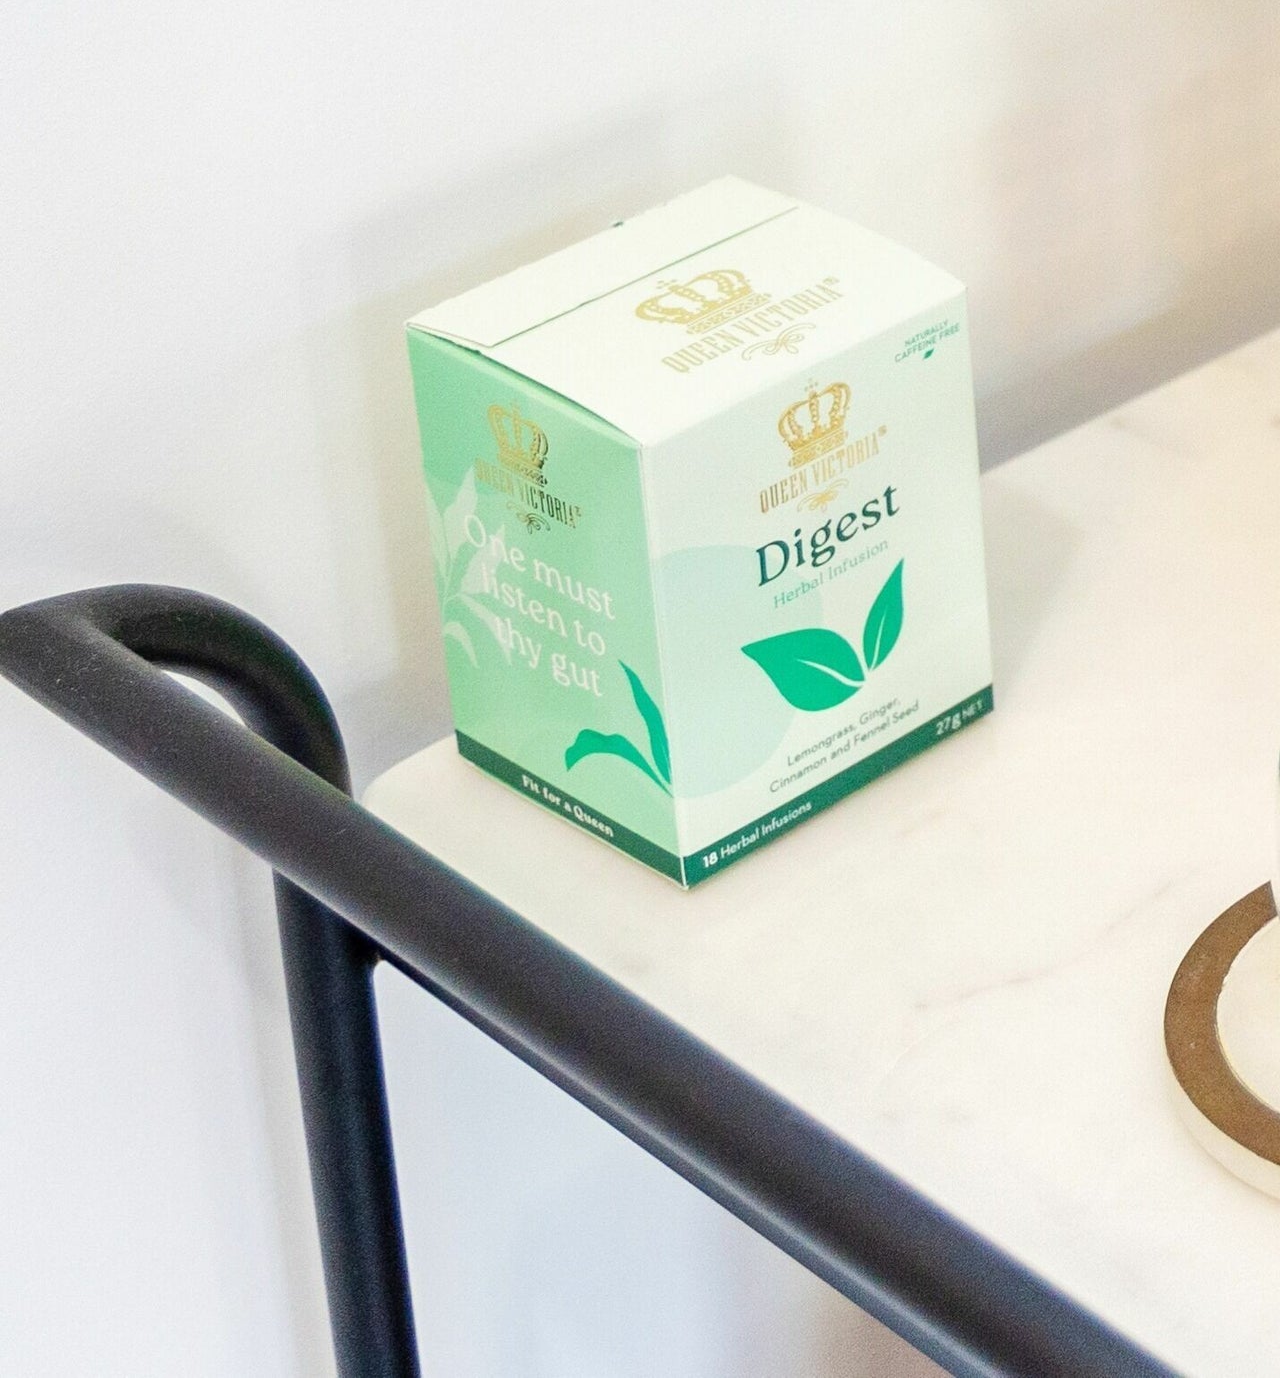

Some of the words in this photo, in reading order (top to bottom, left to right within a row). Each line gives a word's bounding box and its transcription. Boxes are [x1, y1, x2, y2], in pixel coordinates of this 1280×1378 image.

[661, 329, 745, 373] QUEEN
[894, 334, 936, 363] CAFFEINE
[939, 322, 960, 340] FREE
[759, 468, 808, 514] QUEEN
[465, 514, 526, 572] One
[533, 558, 615, 620] must
[755, 485, 900, 587] Digest
[773, 572, 824, 609] Herbal
[828, 539, 889, 581] Infusion
[482, 563, 567, 638] listen
[572, 619, 606, 656] to
[495, 616, 542, 669] thy
[551, 653, 603, 698] gut
[769, 756, 827, 794] Cinnamon
[830, 742, 850, 761] and
[853, 716, 891, 746] Fennel
[892, 700, 920, 724] Seed
[787, 723, 856, 767] Lemongrass,
[859, 697, 901, 726] Ginger,
[522, 774, 540, 794] Fit
[542, 787, 561, 806] for
[563, 801, 572, 814] a
[573, 805, 614, 838] Queen
[702, 851, 718, 868] 18
[720, 827, 760, 859] Herbal
[761, 801, 812, 836] Infusions
